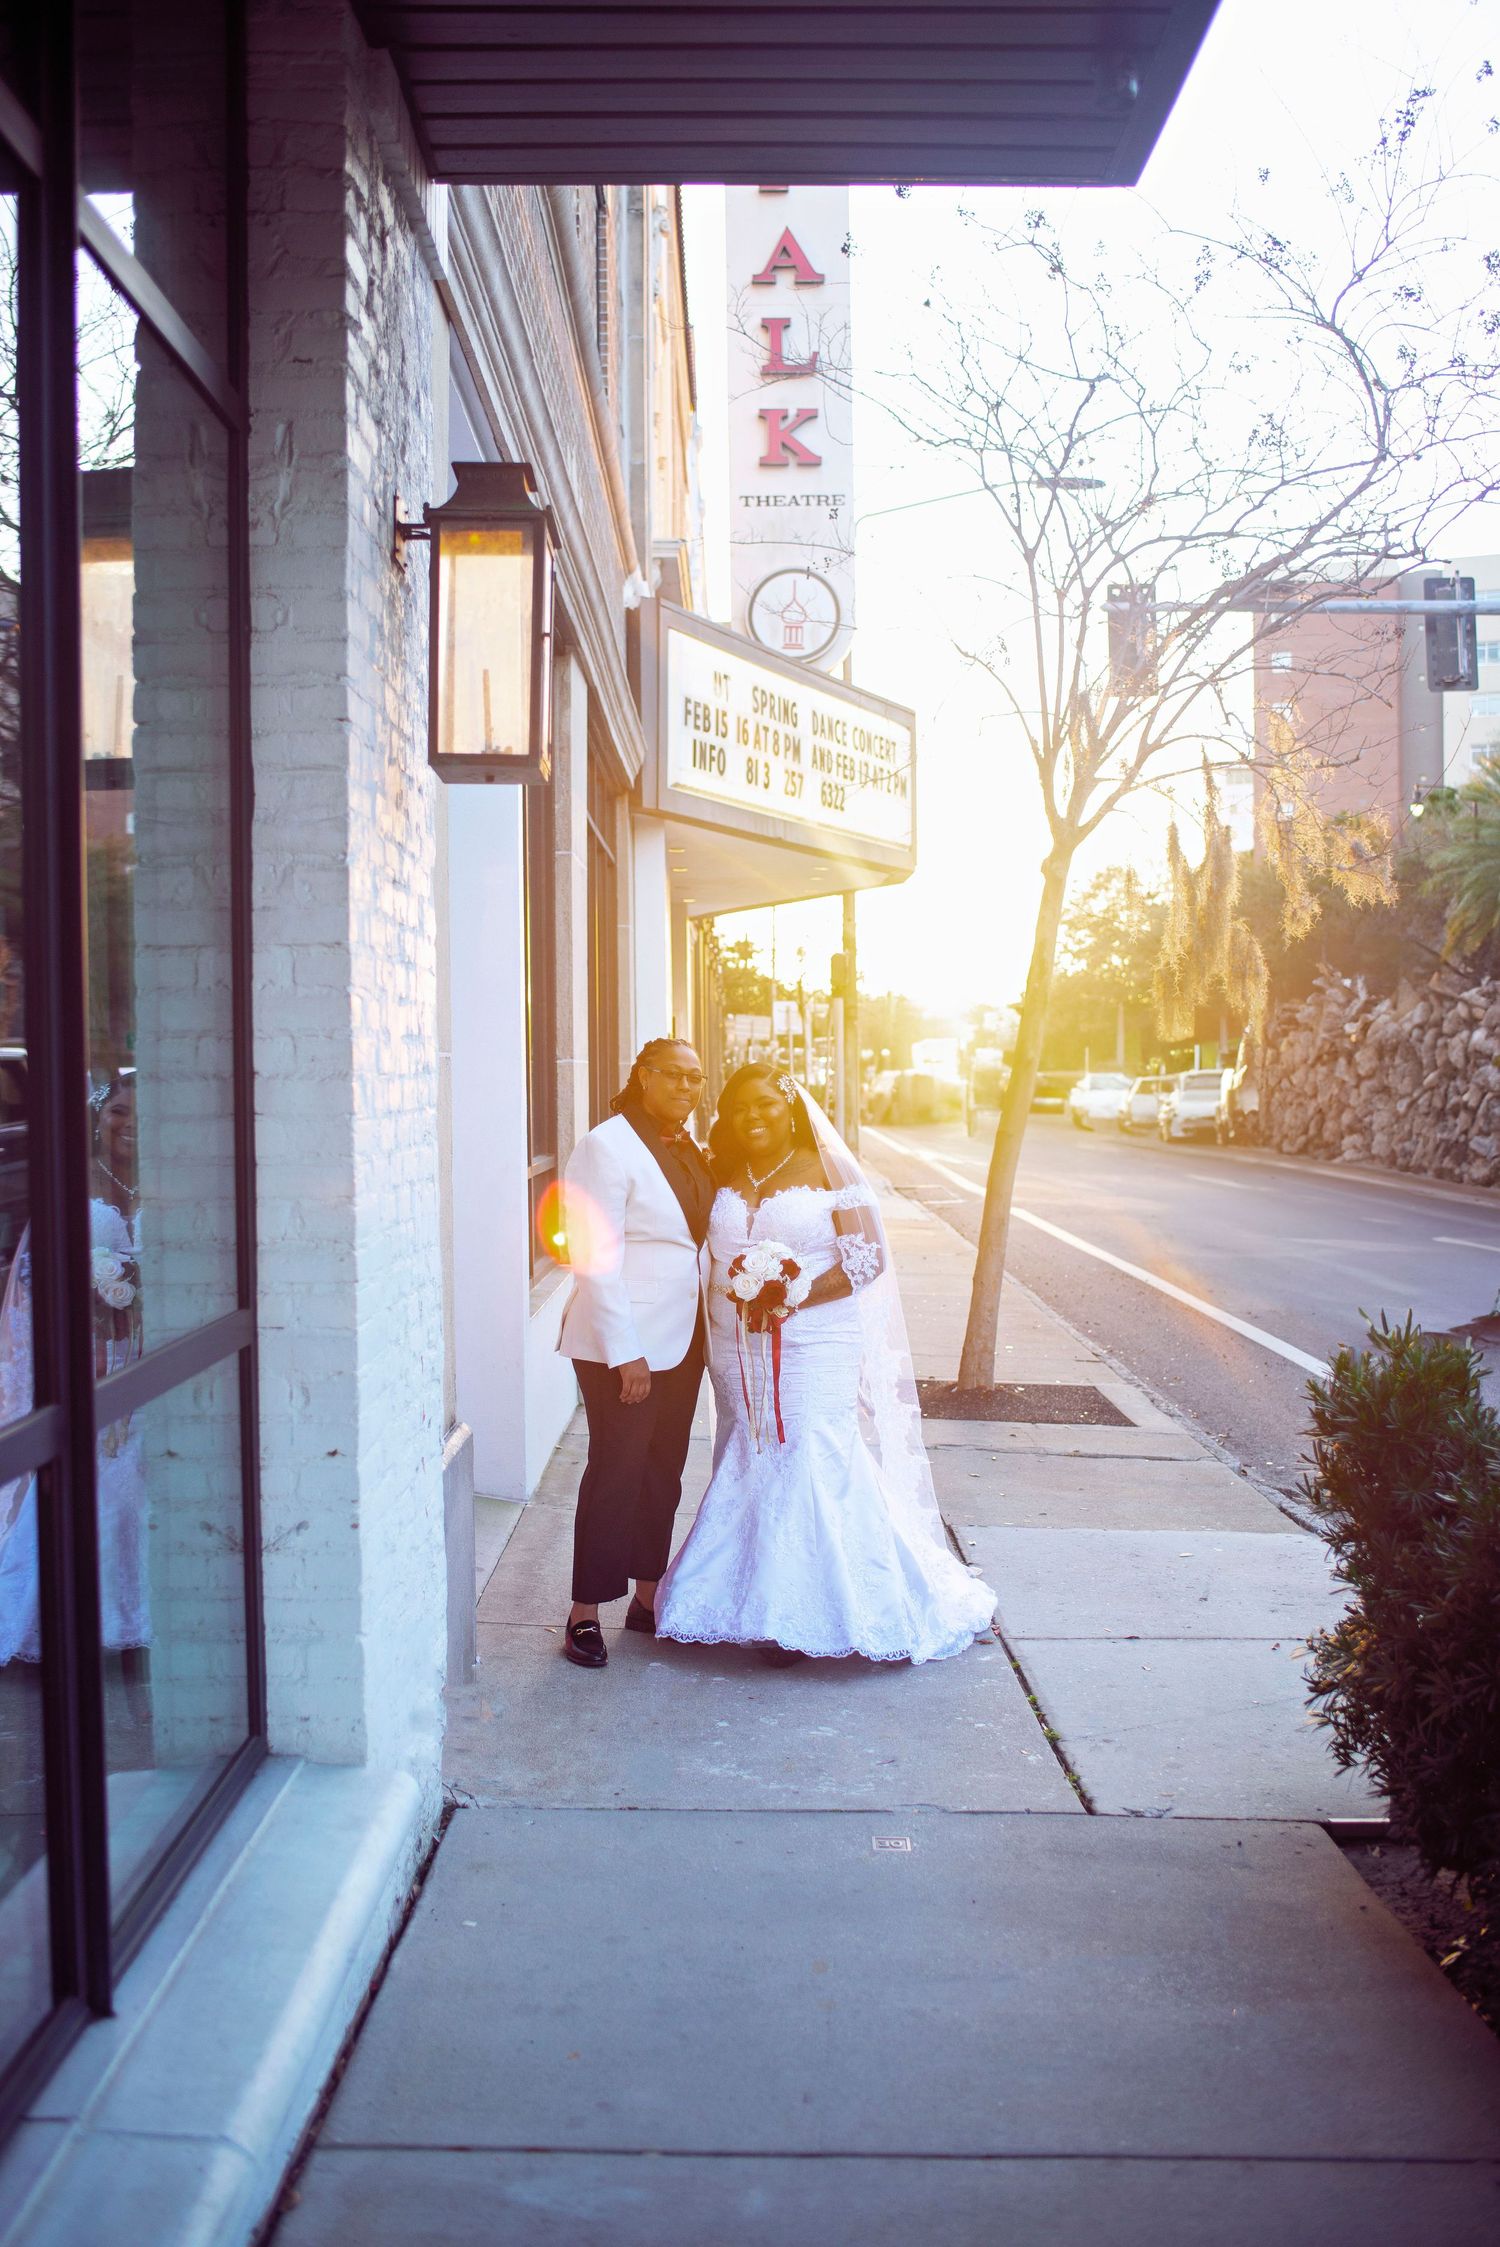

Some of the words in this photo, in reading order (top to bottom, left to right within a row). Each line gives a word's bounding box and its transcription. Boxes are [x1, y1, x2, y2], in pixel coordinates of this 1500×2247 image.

[752, 187, 826, 468] ALK
[739, 494, 846, 507] THEATRE
[684, 696, 711, 733] FEB
[715, 707, 728, 739] 15
[736, 715, 750, 746] 16
[753, 721, 770, 753] AT
[772, 729, 780, 757] 8
[784, 733, 801, 764] PM
[811, 744, 834, 774] AND
[836, 753, 856, 782] FEB
[894, 773, 908, 800] PM
[752, 685, 798, 728] SPRING
[812, 709, 848, 747] DANCE
[852, 727, 897, 764] CONCERT
[692, 738, 727, 777] INFO
[784, 769, 804, 800] 257
[820, 781, 846, 812] 6322
